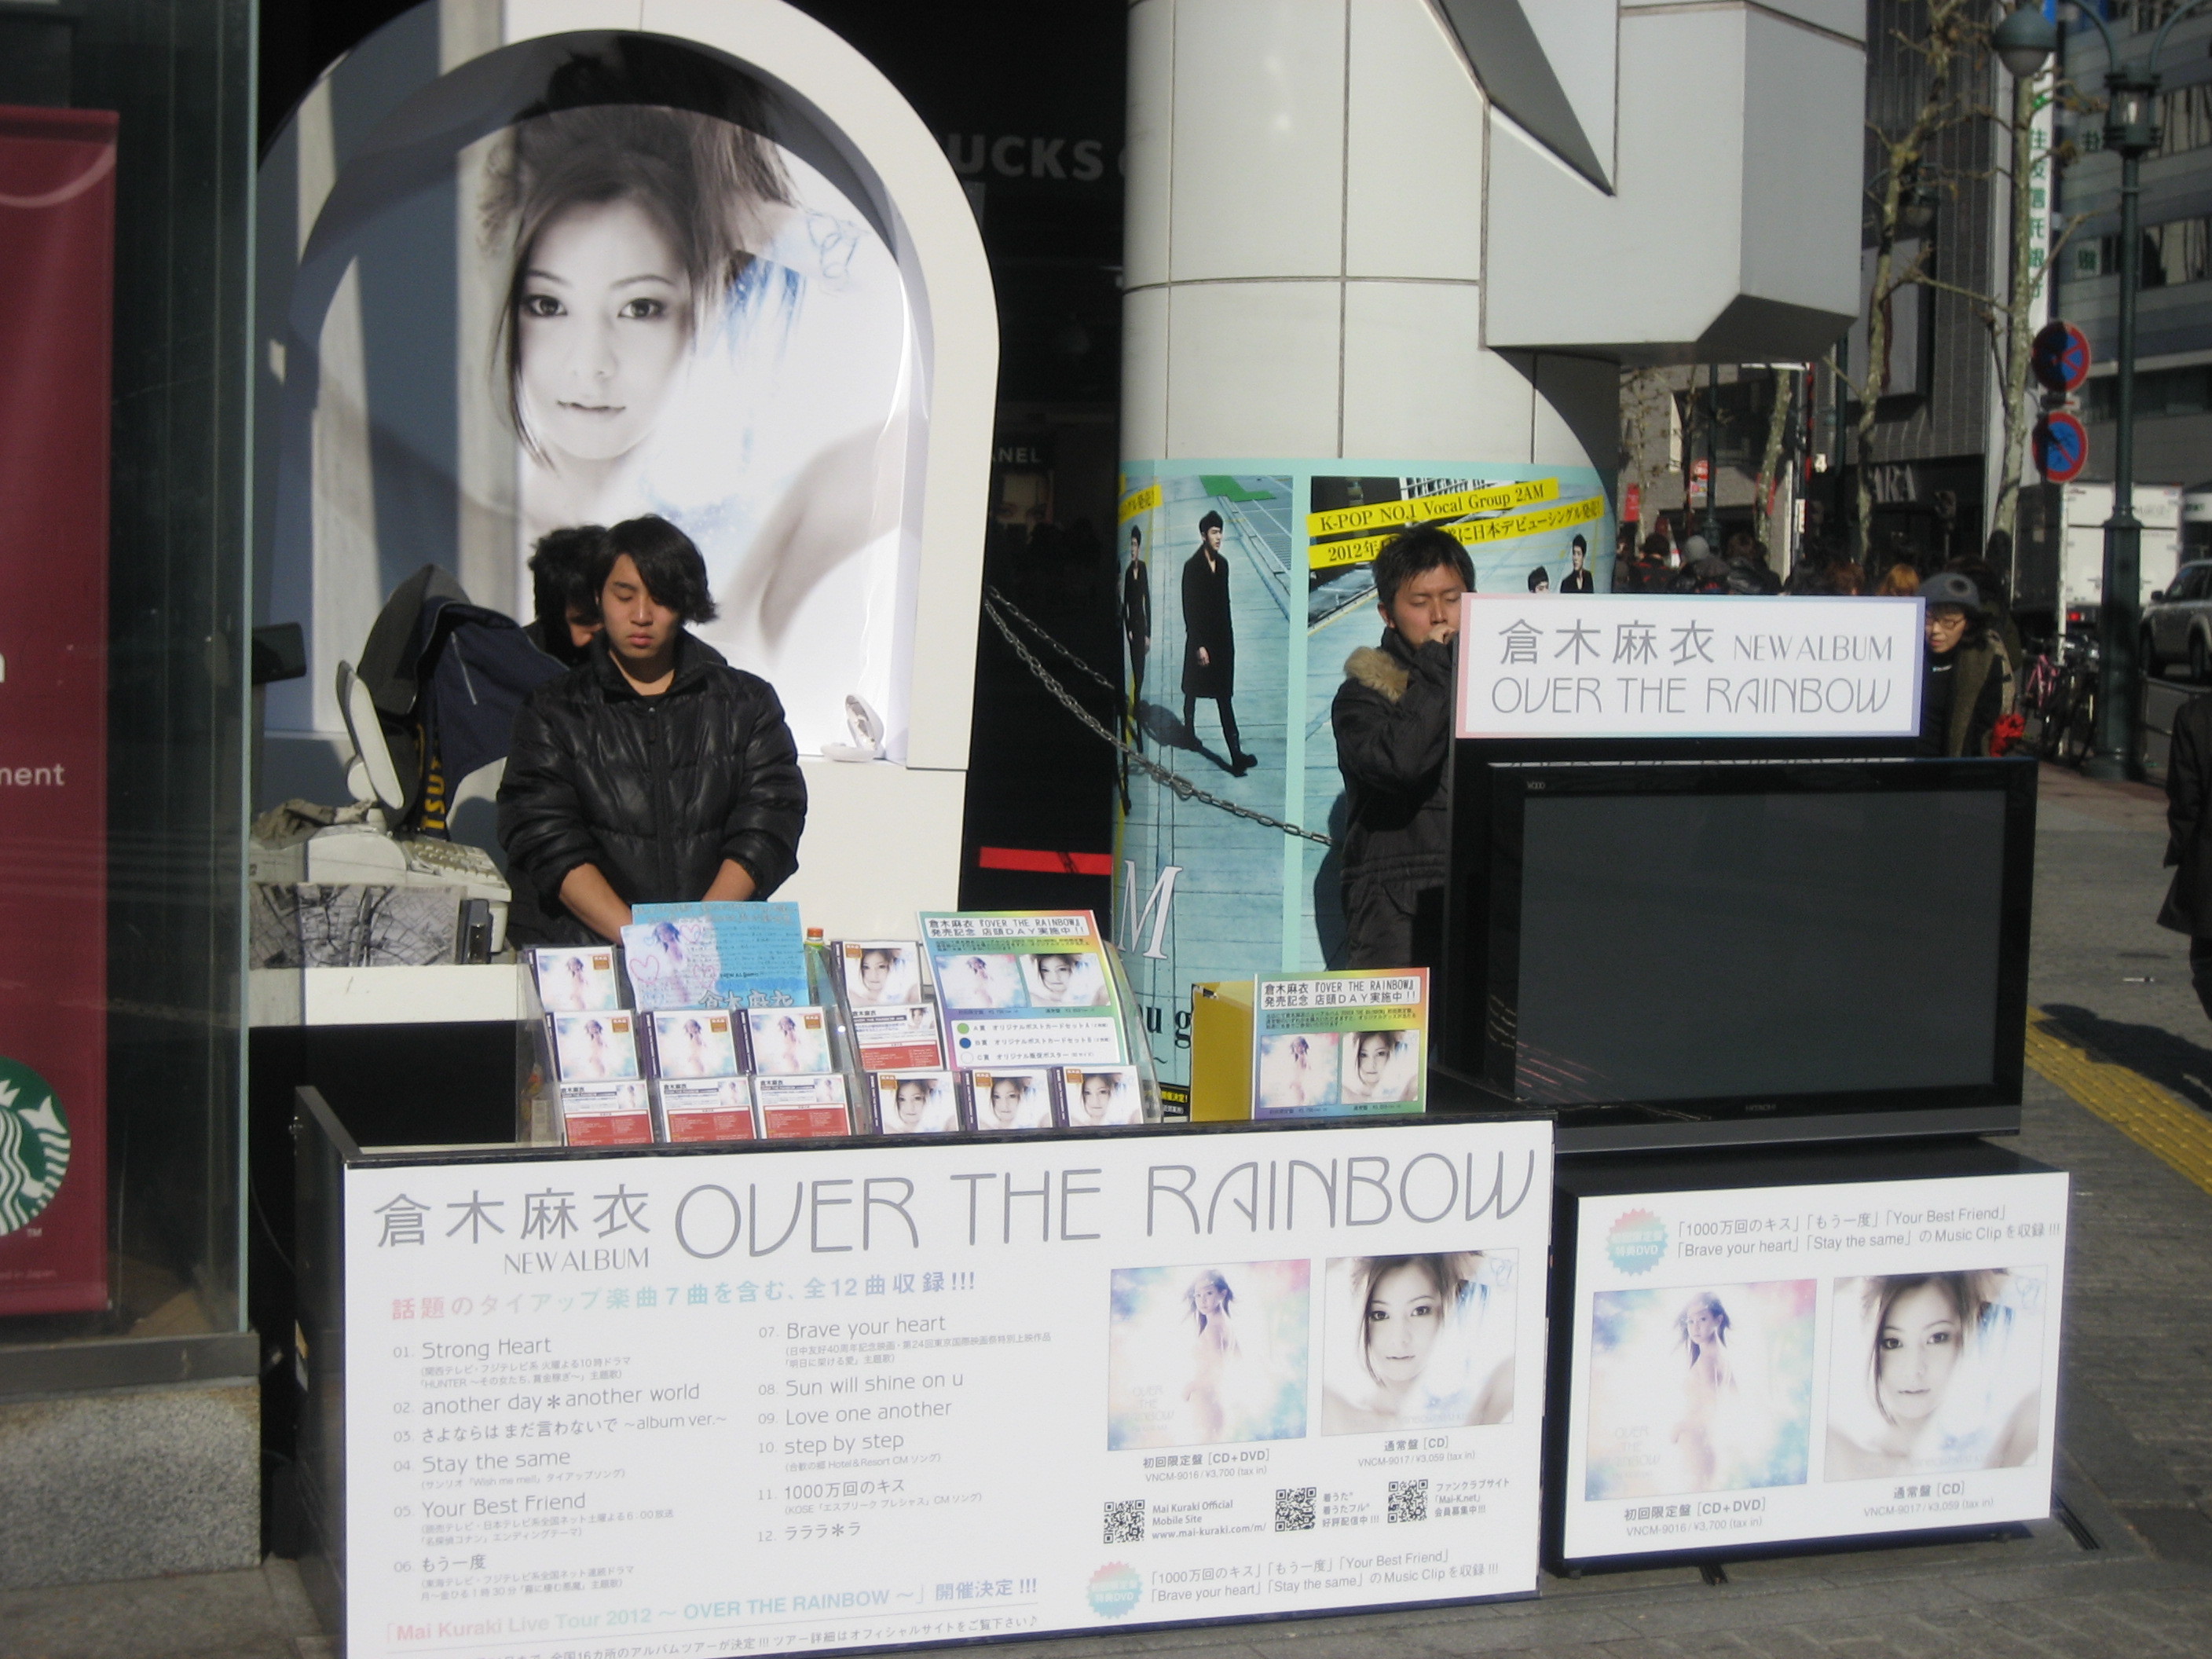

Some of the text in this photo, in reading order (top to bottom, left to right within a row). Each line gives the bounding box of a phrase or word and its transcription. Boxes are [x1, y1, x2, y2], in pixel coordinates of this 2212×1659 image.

[993, 447, 1041, 463] NEL
[1320, 484, 1546, 533] K-POP NO.1 Vocal Group 2AM
[1497, 617, 1893, 667] 倉木麻衣 NEW ALBUM
[1492, 677, 1892, 715] OVER THE RAINBOW
[1013, 918, 1030, 927] THE
[1265, 983, 1309, 996] 倉木麻衣
[1349, 981, 1364, 992] THE
[373, 1183, 652, 1249] 倉木麻衣
[675, 1149, 1535, 1259] OVER THE RAINBOW
[1927, 1207, 1955, 1222] Best
[1727, 1242, 1756, 1258] your
[1846, 1232, 1866, 1248] the
[1976, 1225, 2003, 1243] Clip
[504, 1247, 650, 1275] NEW ALBUM
[786, 1322, 840, 1339] Brave
[848, 1319, 890, 1339] your
[895, 1315, 947, 1333] heart
[421, 1342, 490, 1361] Strong
[497, 1337, 552, 1355] Heart
[785, 1379, 822, 1397] Sun
[830, 1377, 859, 1394] will
[865, 1374, 915, 1392] shine
[921, 1375, 946, 1389] on
[952, 1373, 965, 1387] u
[422, 1397, 500, 1415] another
[649, 1382, 701, 1401] world
[786, 1409, 829, 1426] Love
[835, 1408, 871, 1423] one
[877, 1401, 953, 1420] another
[784, 1438, 827, 1457] step
[833, 1435, 855, 1454] by
[862, 1433, 905, 1451] step
[1384, 1438, 1419, 1452] 通常盤
[421, 1456, 468, 1474] Stay
[475, 1452, 508, 1470] the
[515, 1450, 571, 1468] same
[892, 1456, 909, 1465] CM
[1143, 1453, 1203, 1469] 初回限定盤
[933, 1495, 950, 1503] CM
[1893, 1484, 1932, 1500] 通常盤
[422, 1500, 466, 1518] Your
[473, 1497, 518, 1516] Best
[525, 1492, 587, 1511] Friend
[1152, 1499, 1233, 1514] Mai Kuraki Official
[1624, 1503, 1692, 1522] 初回限定盤
[1152, 1514, 1203, 1526] Mobile Site
[1152, 1522, 1267, 1540] www.mai-kuraki.com/m/
[422, 1553, 487, 1573] もう一度
[1376, 1551, 1402, 1568] Best
[1195, 1584, 1221, 1601] your
[1303, 1575, 1322, 1591] the
[1421, 1566, 1446, 1582] Clip
[438, 1617, 502, 1639] Kuraki
[508, 1614, 550, 1634] Live
[555, 1610, 600, 1630] Tour
[606, 1608, 652, 1626] 2012
[683, 1600, 741, 1620] OVER
[747, 1597, 786, 1615] THE
[793, 1589, 890, 1611] RAINBOW
[935, 1578, 1014, 1602] 開催決定
